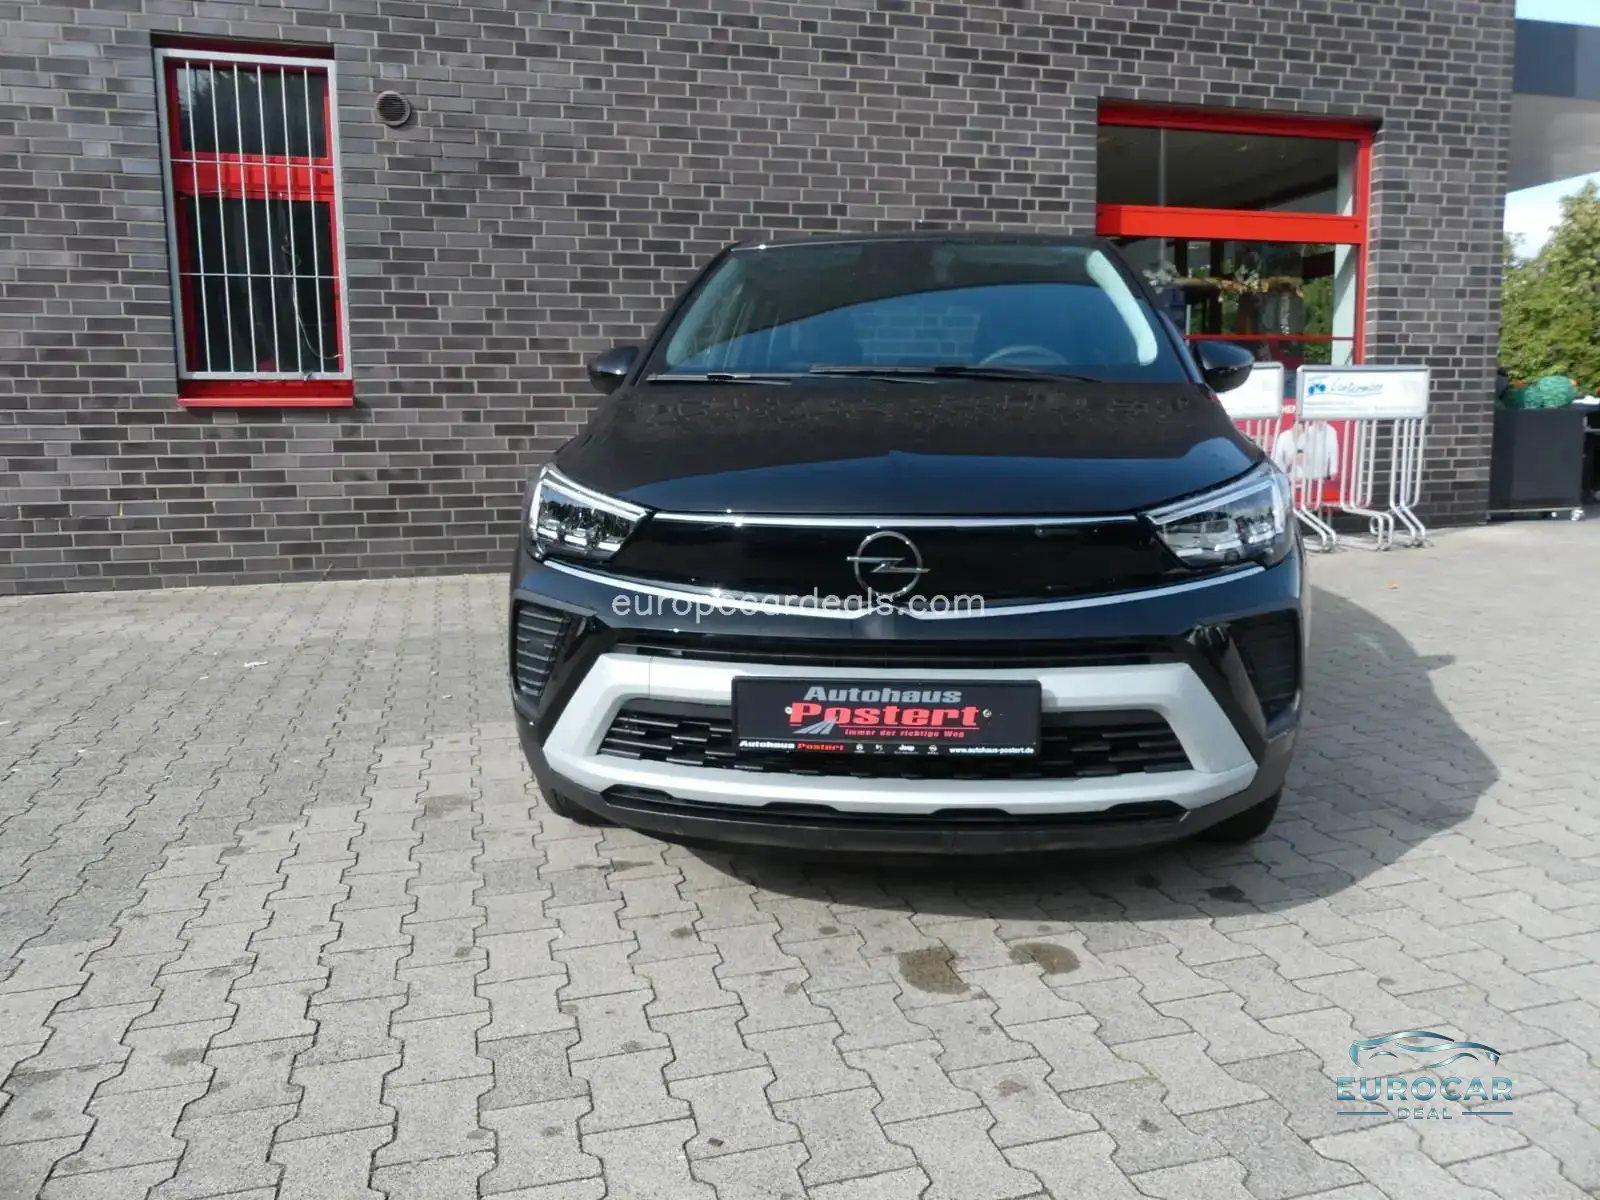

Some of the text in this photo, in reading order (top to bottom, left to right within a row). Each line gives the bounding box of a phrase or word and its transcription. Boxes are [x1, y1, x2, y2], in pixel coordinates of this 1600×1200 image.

[803, 686, 962, 703] Autohaus
[789, 702, 980, 727] Postert
[880, 729, 897, 737] der
[900, 729, 940, 738] richtige
[943, 730, 965, 738] Weg
[739, 740, 844, 751] Autohaus Postert
[949, 746, 1035, 755] www.autohaus-postert.de
